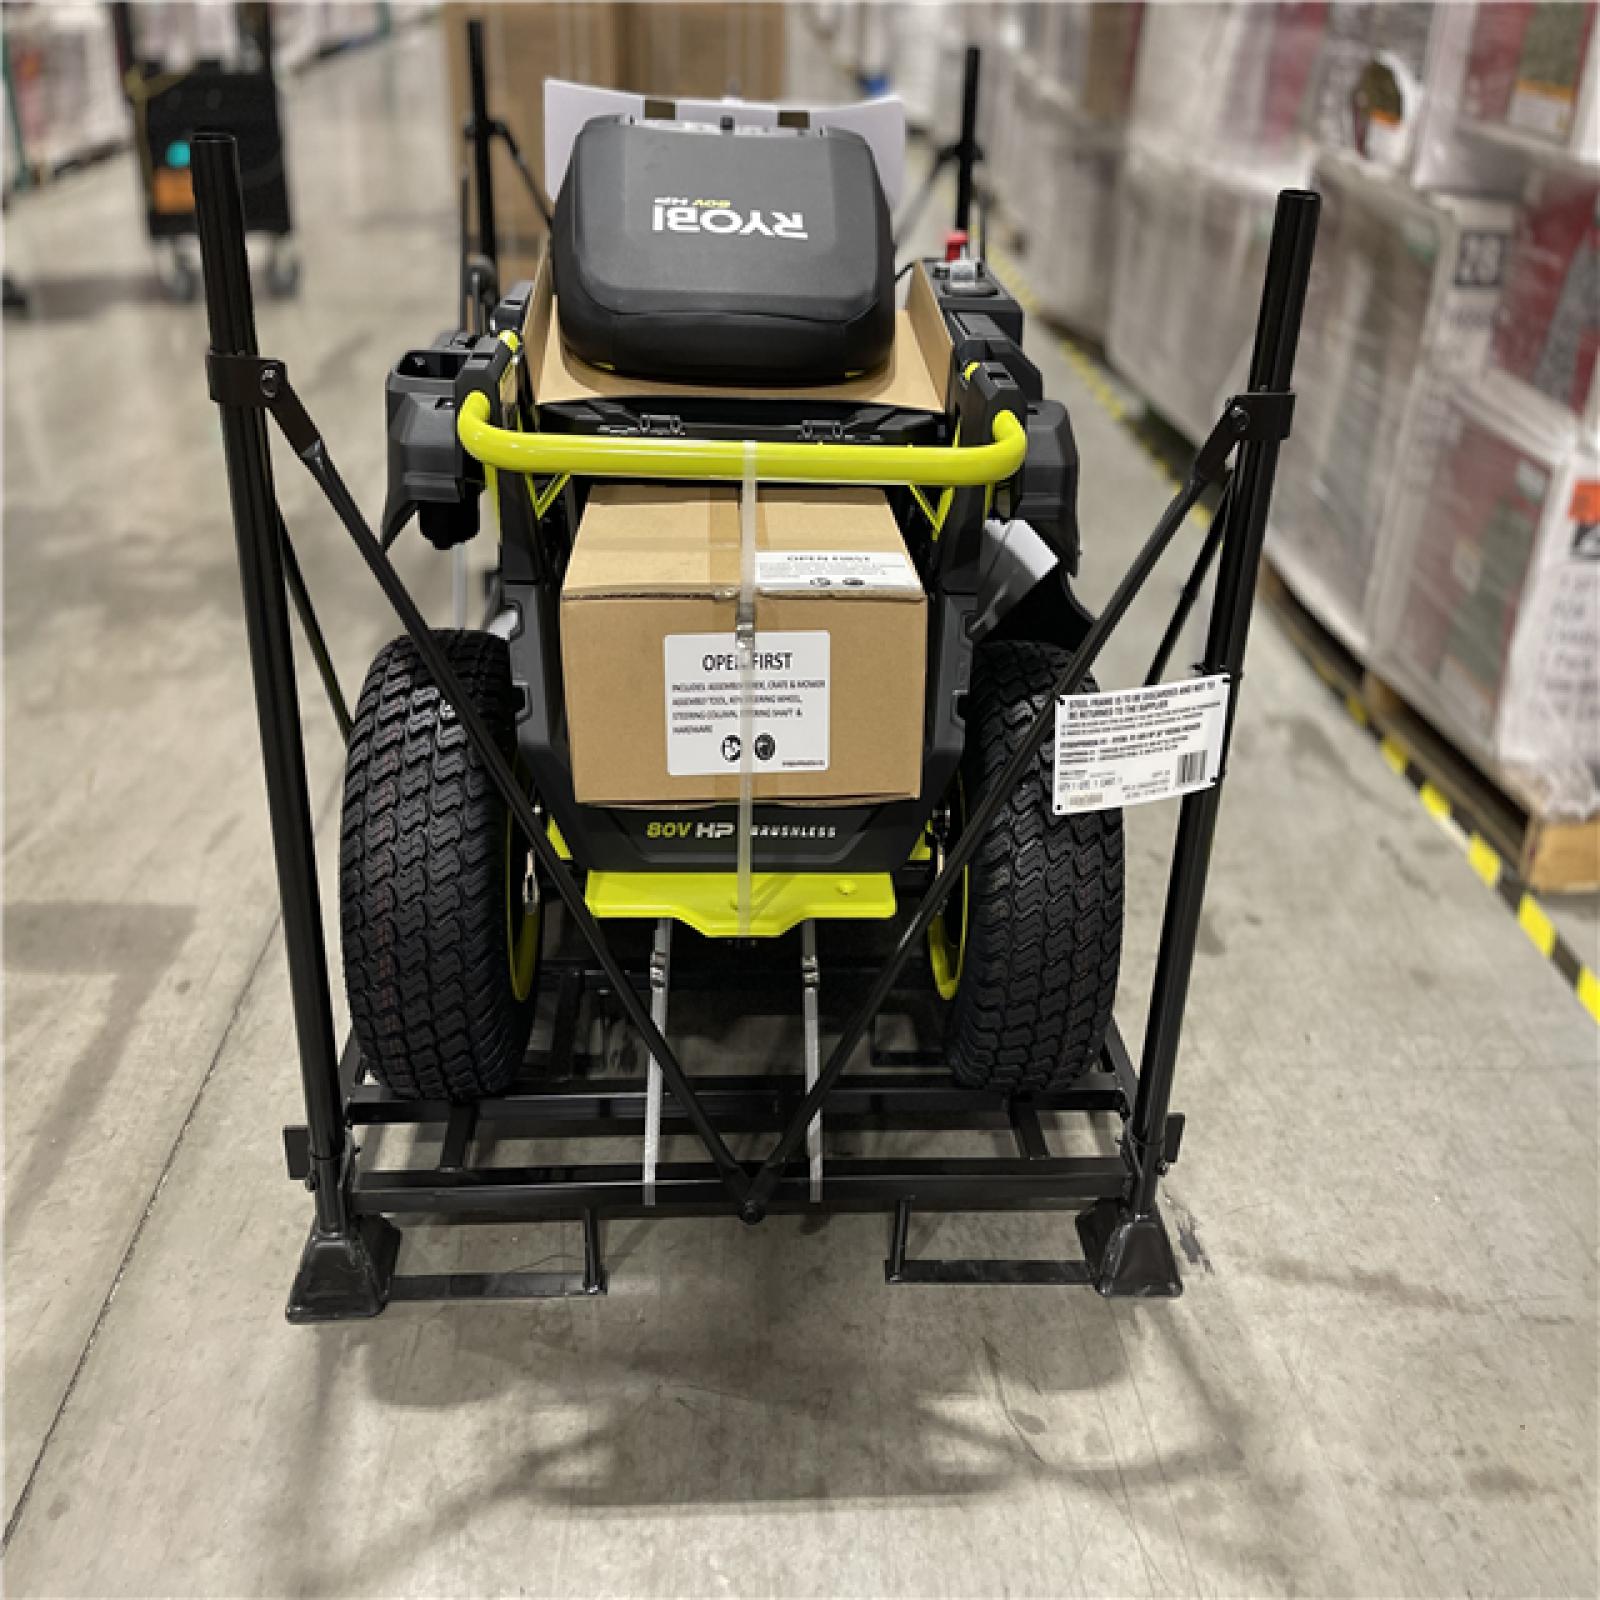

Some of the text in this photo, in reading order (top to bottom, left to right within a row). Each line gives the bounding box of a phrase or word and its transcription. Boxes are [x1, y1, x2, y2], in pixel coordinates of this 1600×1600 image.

[652, 204, 808, 240] RYOBI
[751, 652, 793, 671] FIRST
[647, 822, 692, 839] 80V
[695, 823, 735, 839] HP
